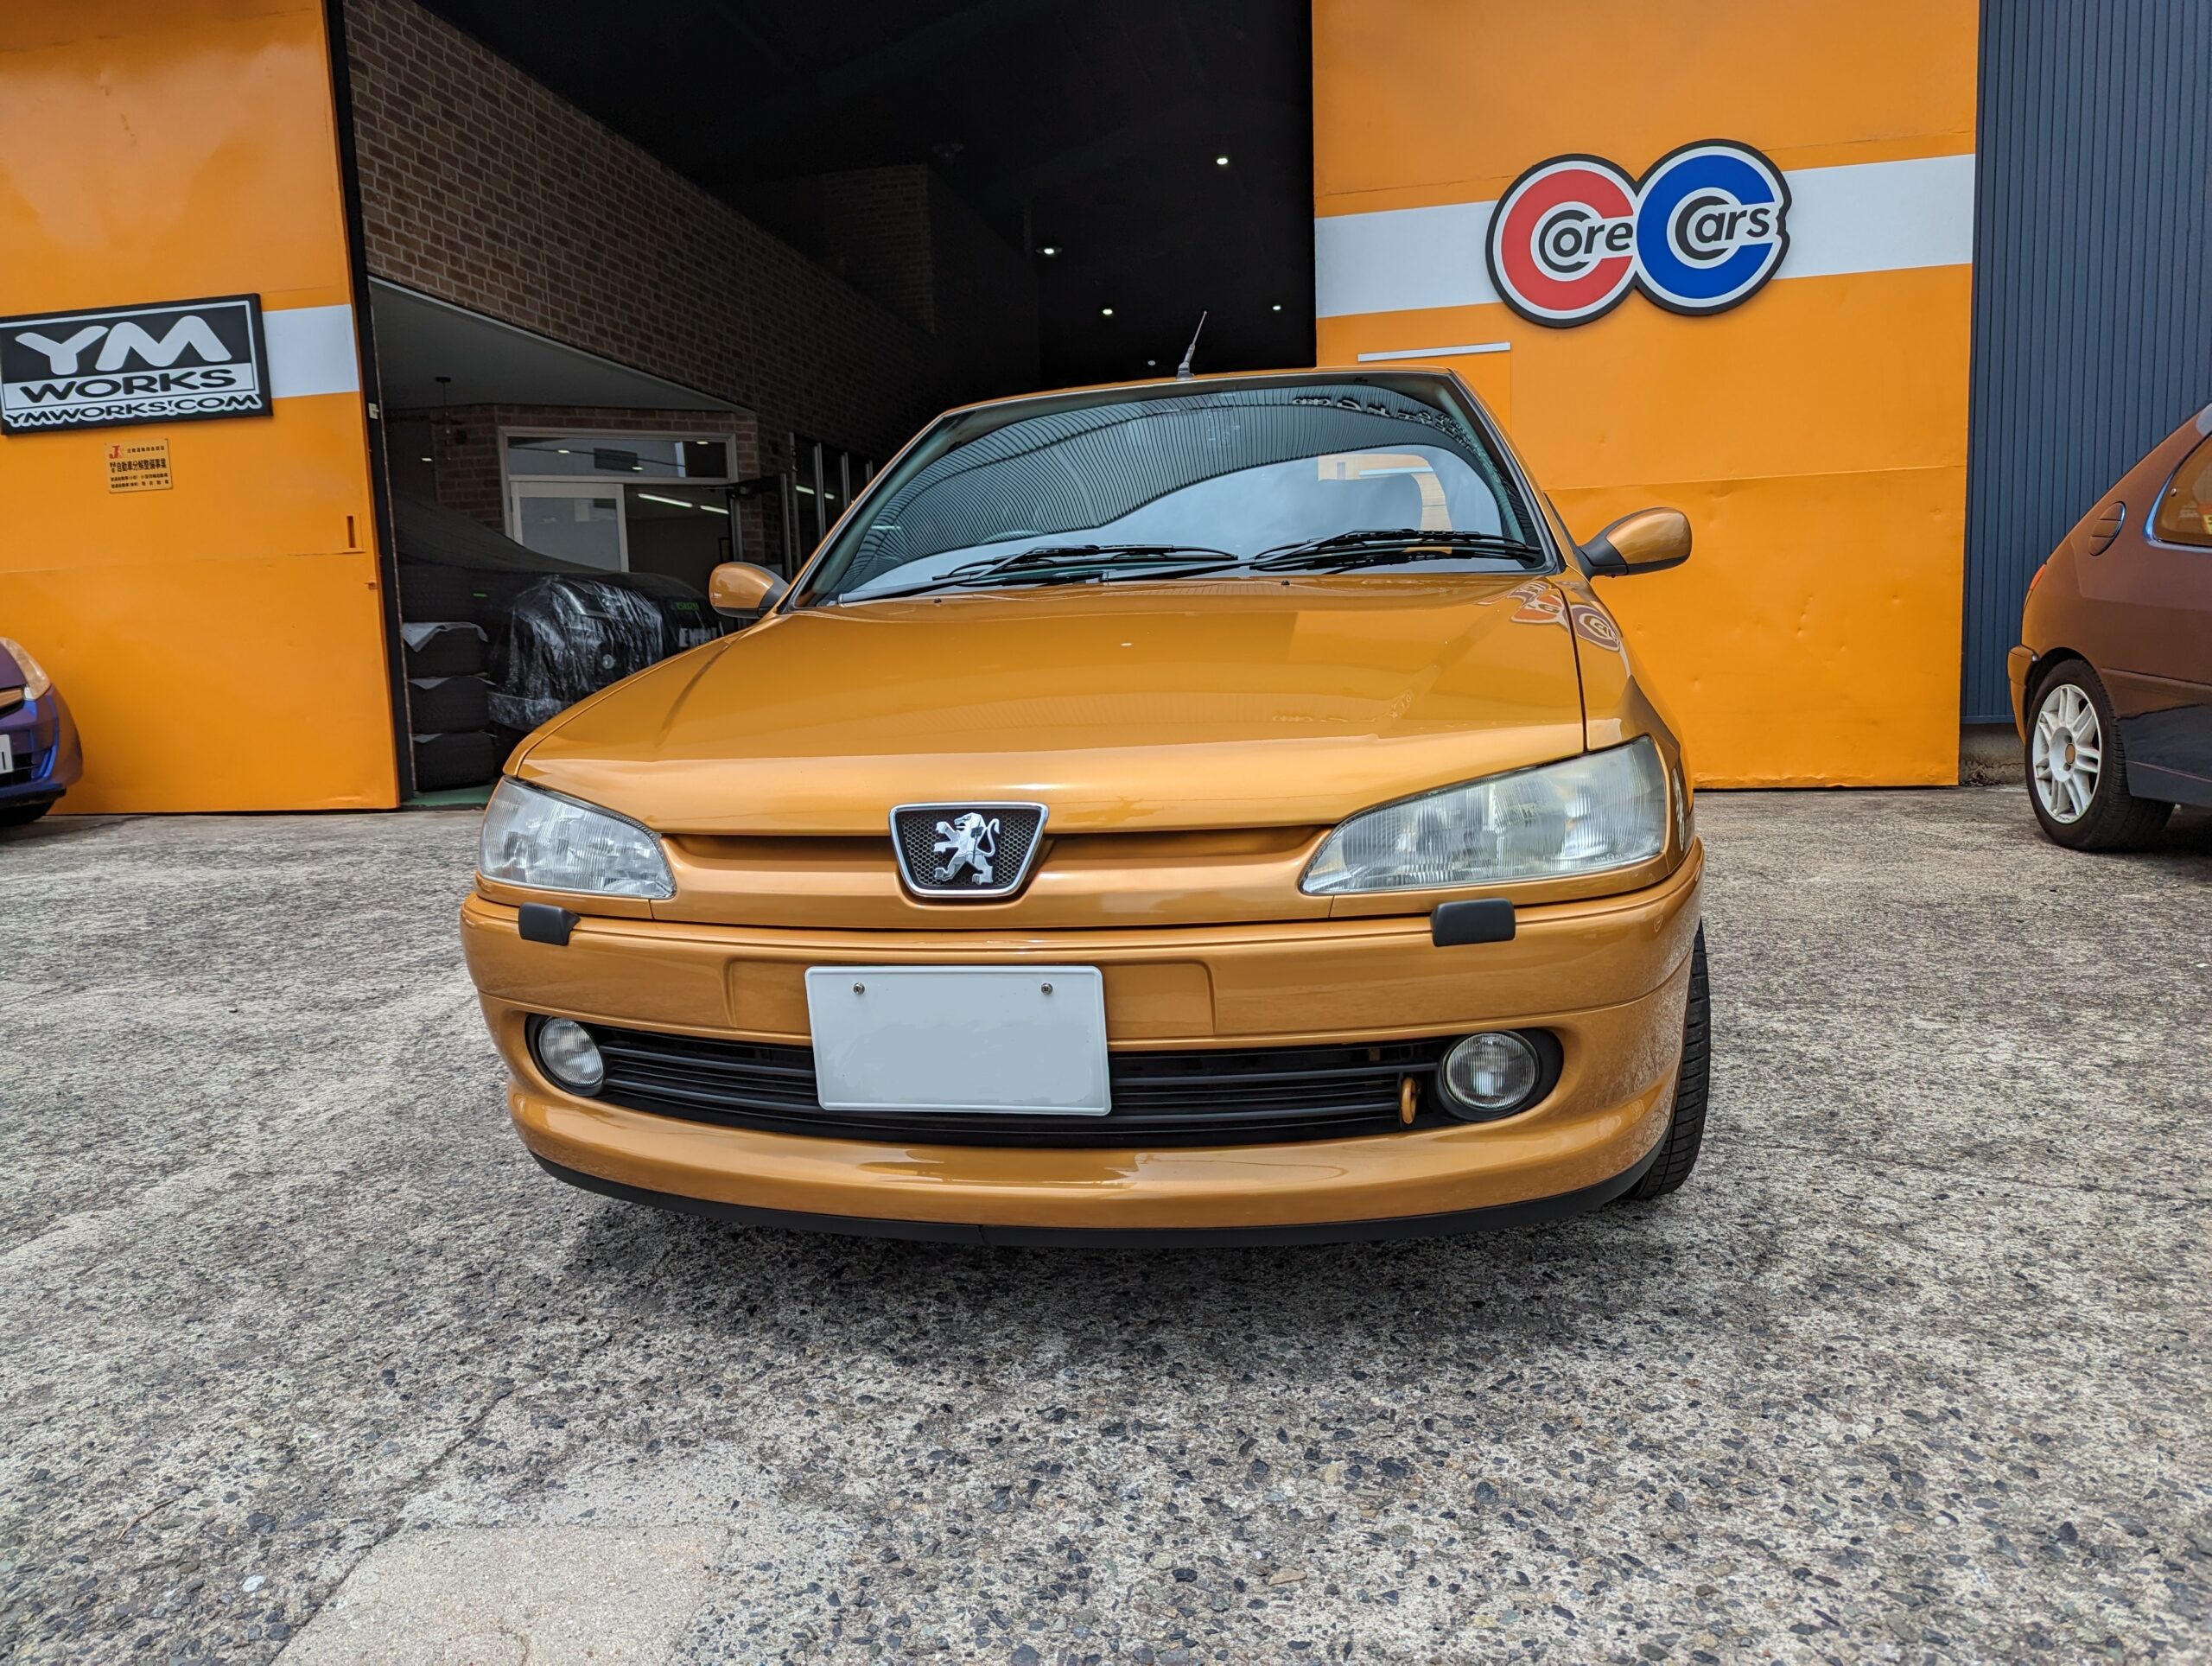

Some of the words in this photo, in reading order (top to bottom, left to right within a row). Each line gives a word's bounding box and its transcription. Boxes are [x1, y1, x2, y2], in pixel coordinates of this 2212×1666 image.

[1538, 209, 1633, 274] Core
[1675, 195, 1770, 261] Cars
[15, 315, 232, 376] YM
[19, 368, 236, 404] WORKS
